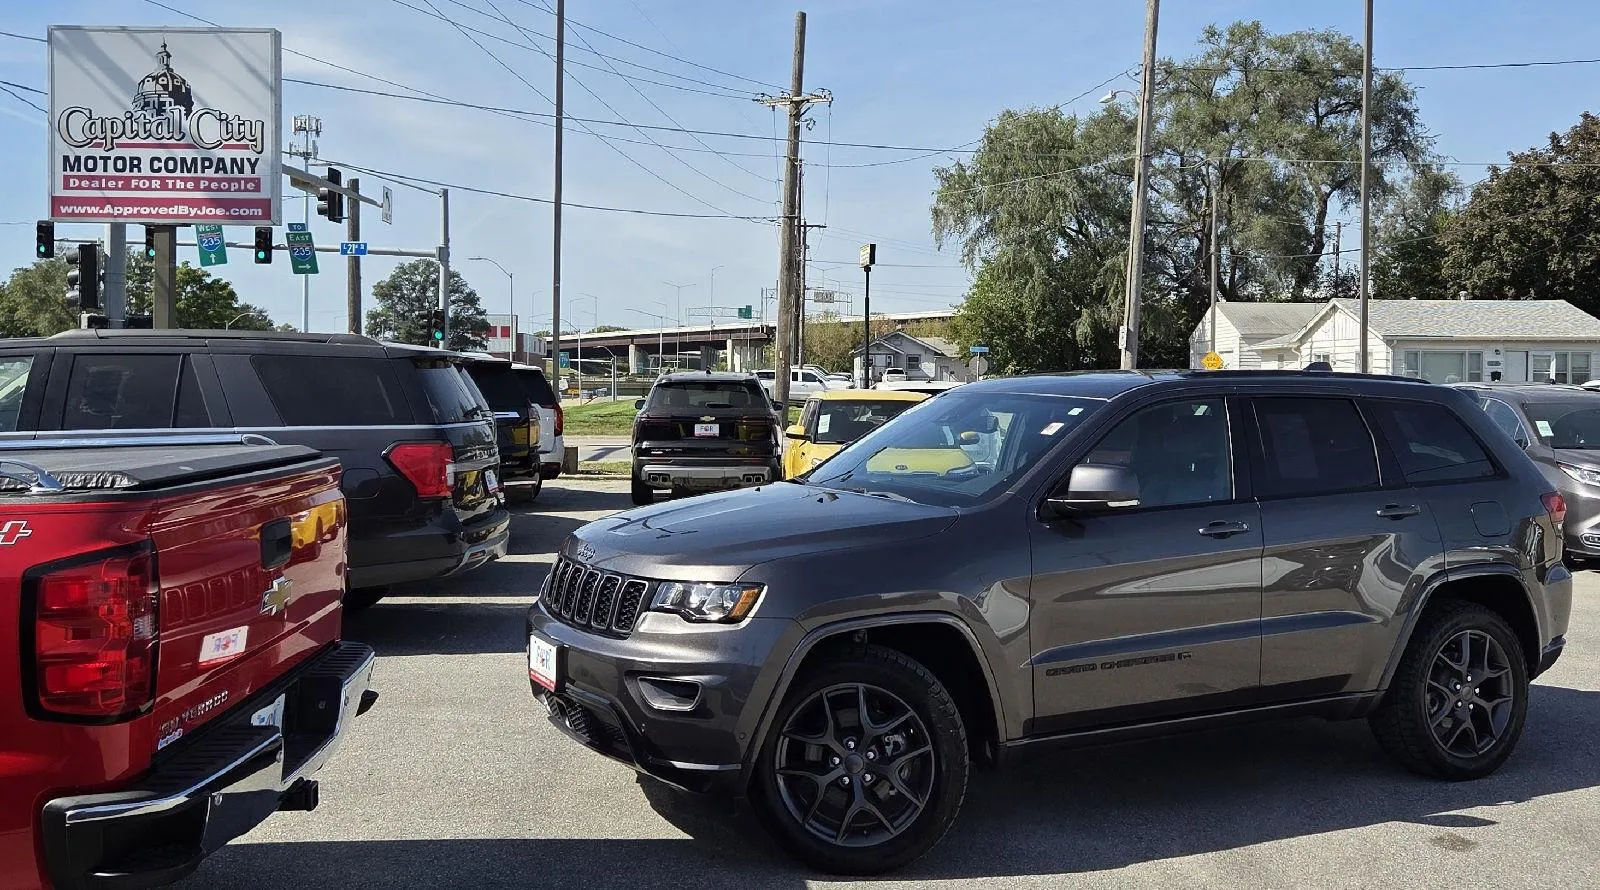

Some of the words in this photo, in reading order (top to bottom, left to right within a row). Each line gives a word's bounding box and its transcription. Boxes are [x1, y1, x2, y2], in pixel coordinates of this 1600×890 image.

[58, 106, 185, 152] Capital
[189, 107, 264, 154] City
[62, 154, 142, 173] MOTOR
[150, 156, 260, 175] COMPANY
[69, 178, 124, 189] Dealer
[131, 179, 161, 189] FOR
[166, 179, 194, 190] The
[60, 203, 263, 217] www.ApprovedByJoe.com
[202, 236, 221, 247] 235
[293, 247, 311, 256] 235
